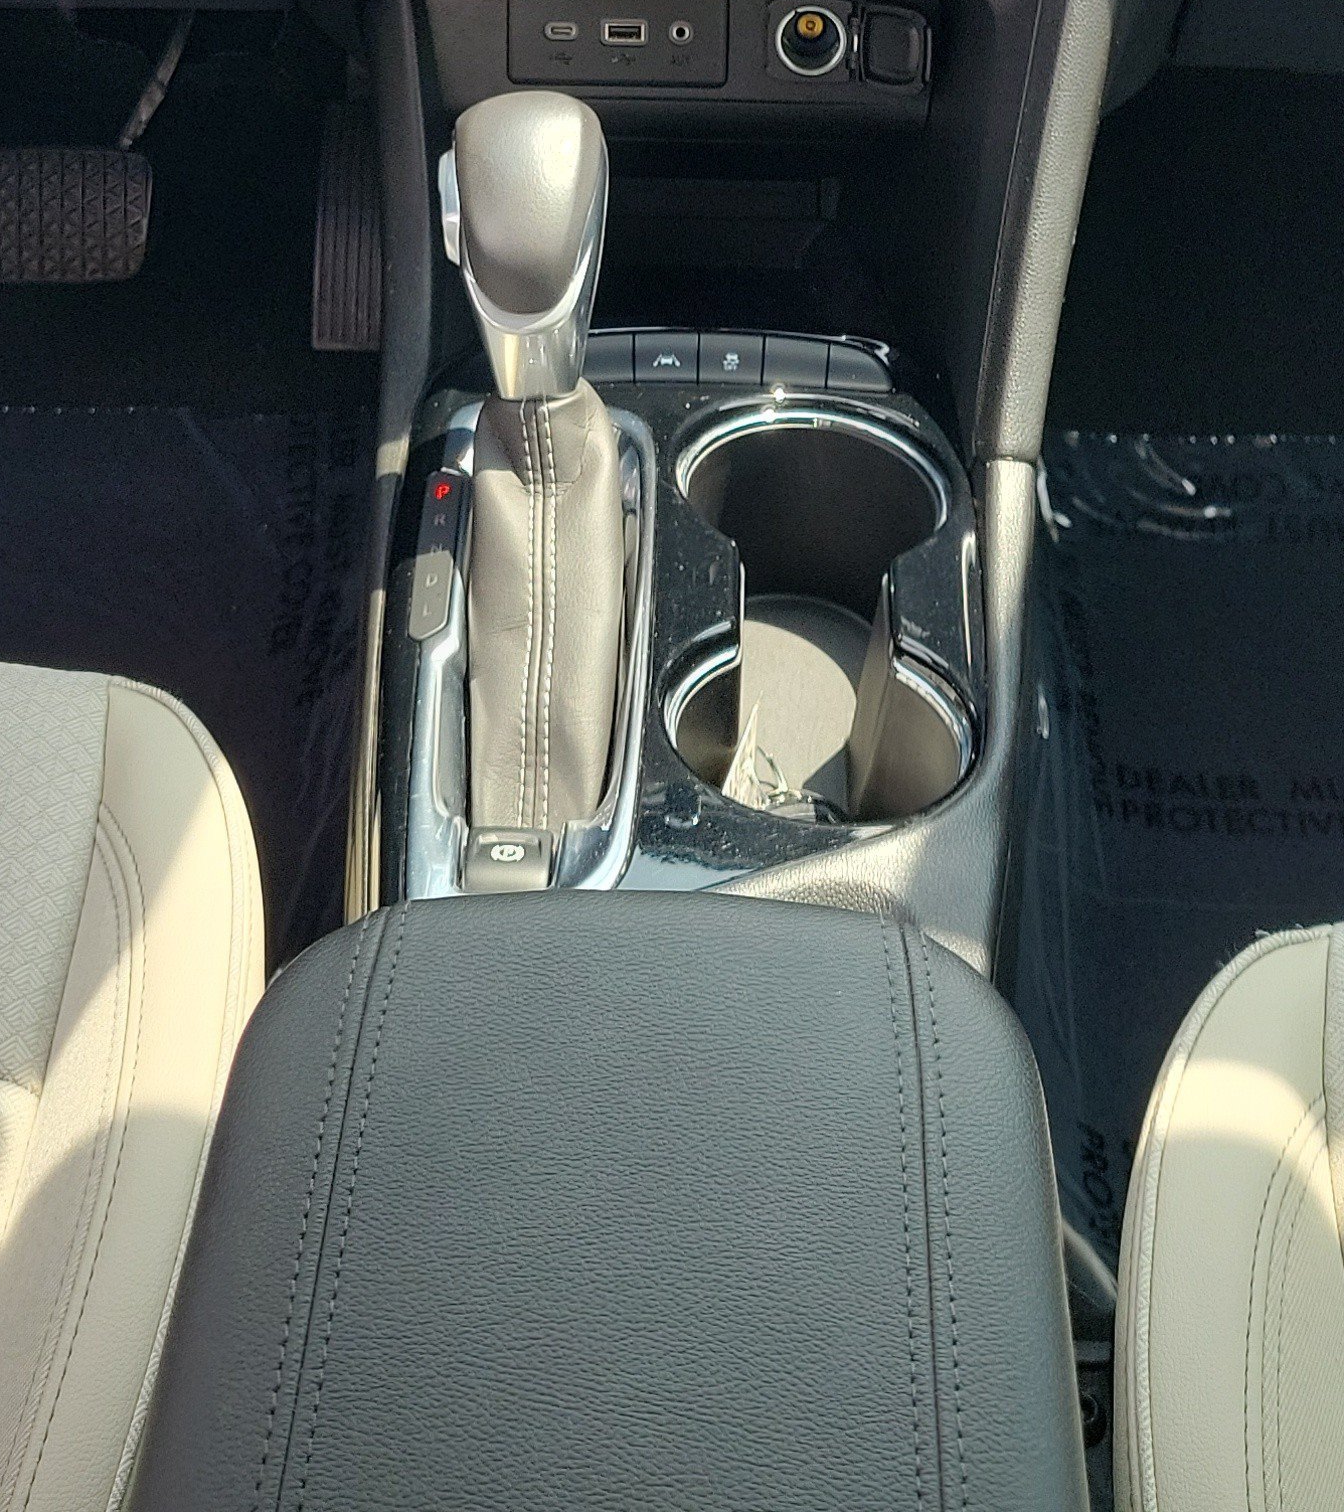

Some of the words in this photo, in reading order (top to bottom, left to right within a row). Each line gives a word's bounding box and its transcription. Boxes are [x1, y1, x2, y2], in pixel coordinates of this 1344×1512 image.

[434, 483, 451, 500] P
[425, 573, 438, 588] D
[422, 603, 432, 617] L
